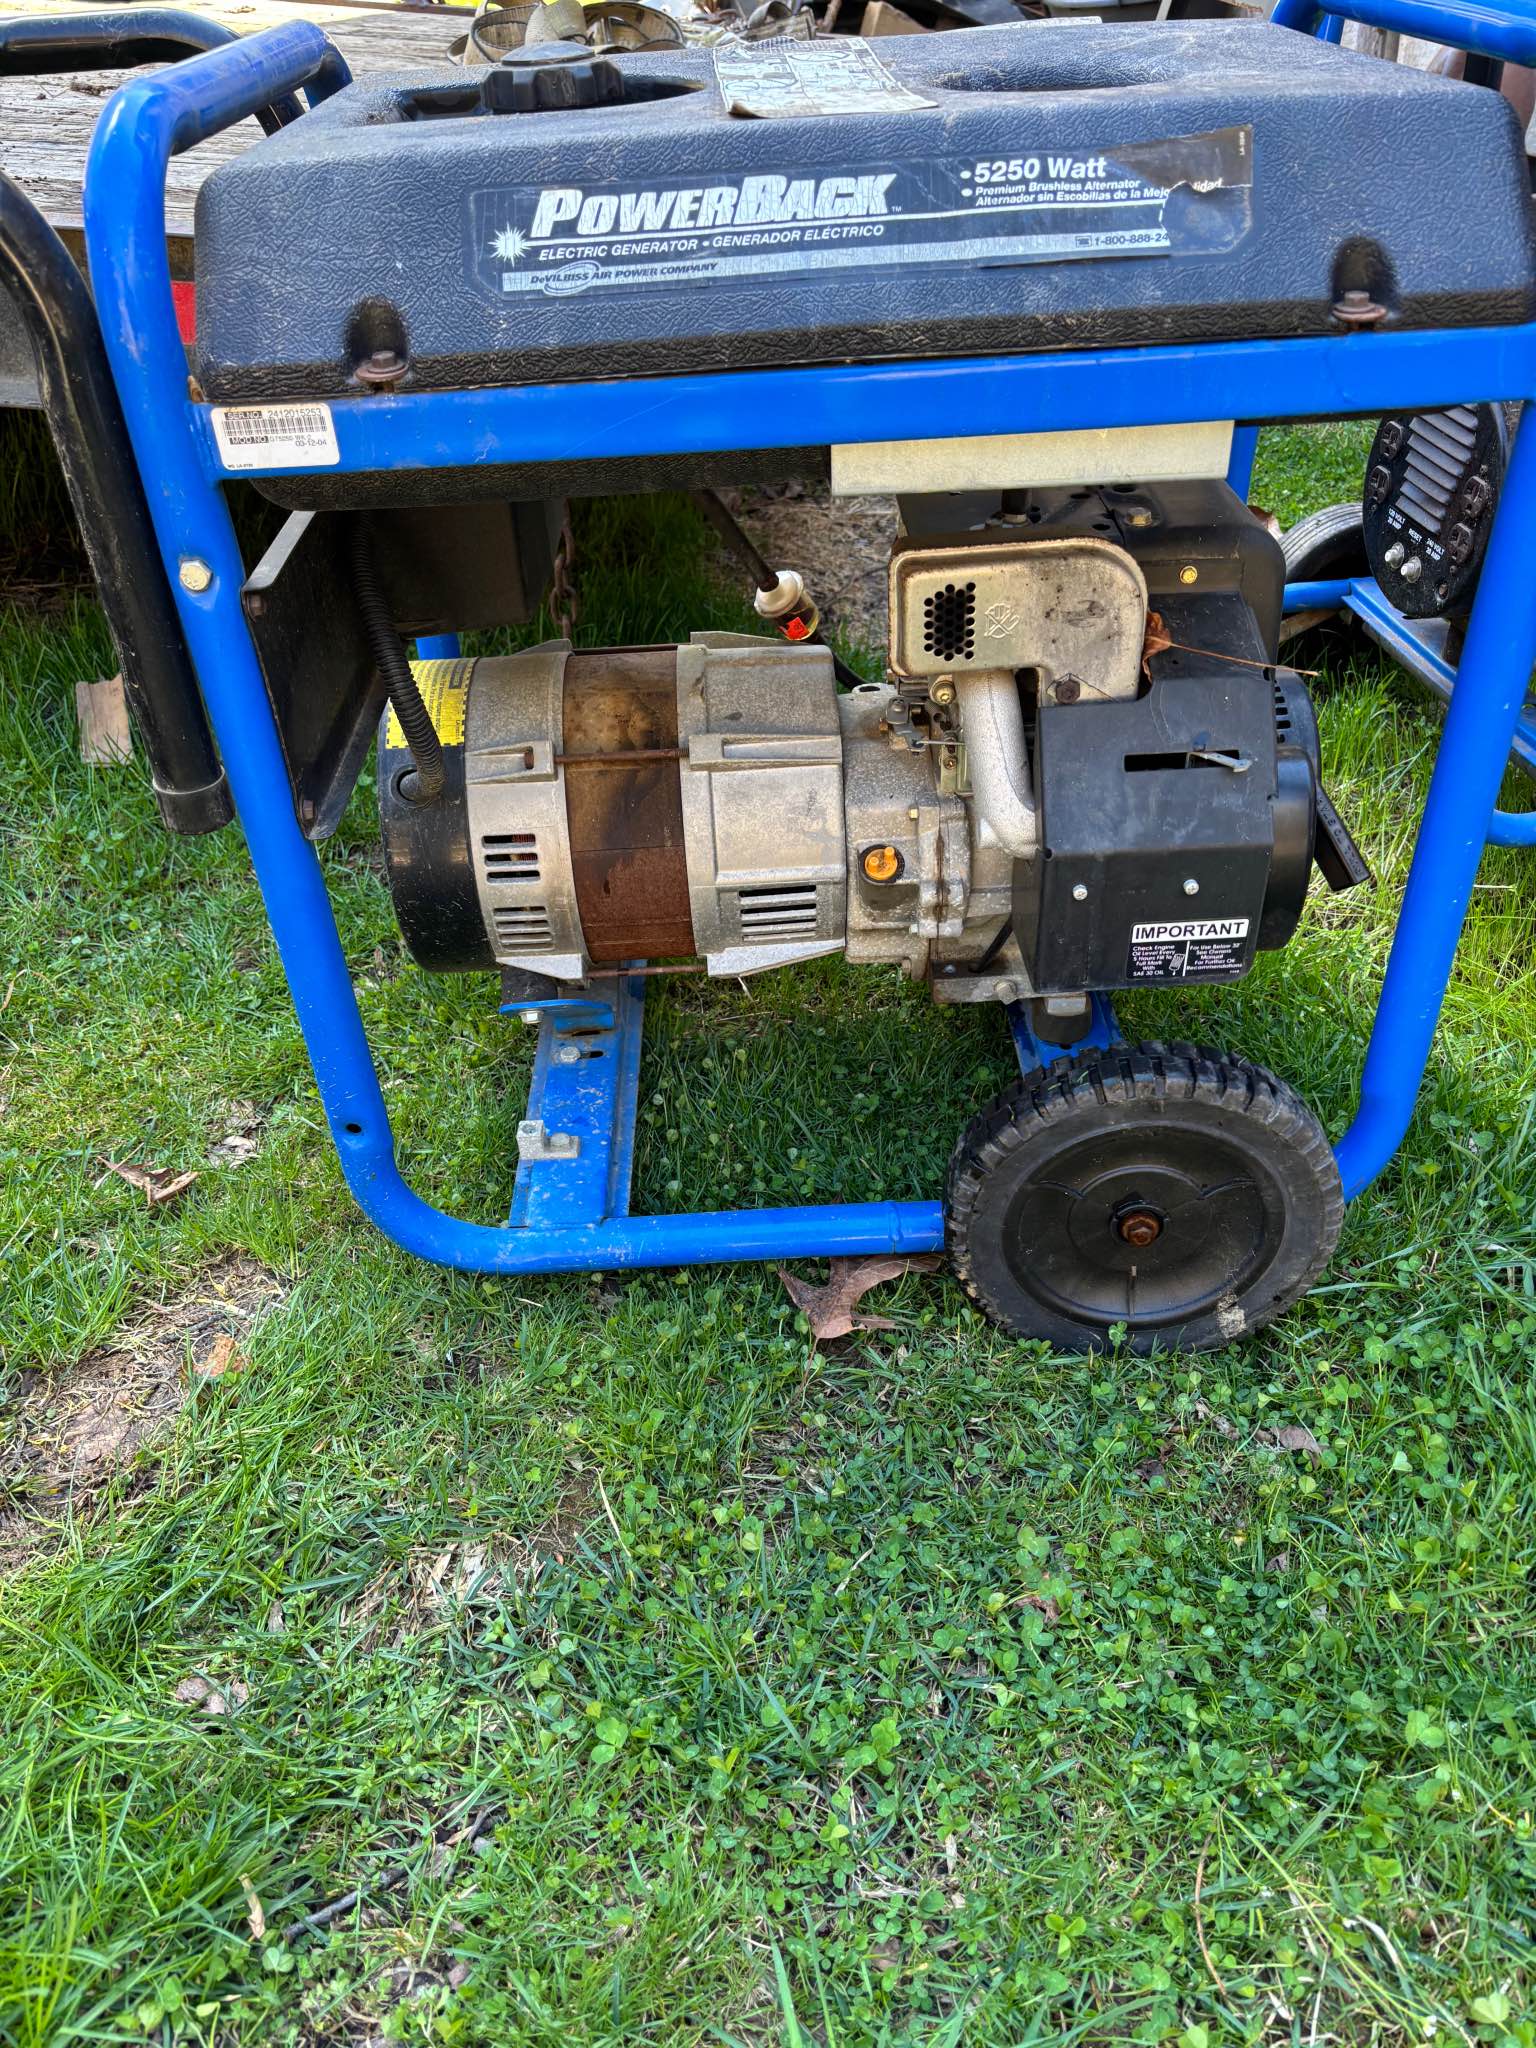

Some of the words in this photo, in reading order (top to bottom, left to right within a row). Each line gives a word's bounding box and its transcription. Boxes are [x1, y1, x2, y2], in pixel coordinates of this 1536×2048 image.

[974, 158, 1041, 183] 5250
[1047, 157, 1107, 178] Watt
[975, 184, 1025, 196] Premium
[1029, 182, 1082, 192] Brushless
[1084, 179, 1141, 190] Alternator
[976, 194, 1034, 206] Alternador
[1037, 193, 1054, 202] sin
[1056, 191, 1110, 201] Escobillas
[1113, 190, 1128, 199] de
[1130, 189, 1140, 198] la
[1143, 188, 1169, 199] Mejo
[539, 245, 608, 261] ELECTRIC
[611, 240, 697, 256] GENERATOR
[712, 231, 800, 247] GENERADOR
[804, 225, 884, 241] ELÉCTRICO
[1095, 233, 1169, 246] 1-800-888-24
[530, 272, 589, 284] DeVILBISS
[592, 271, 612, 280] AIR
[615, 267, 657, 279] POWER
[660, 262, 719, 275] COMPANY
[1408, 528, 1422, 542] RESET
[1135, 922, 1245, 939] IMPORTANT
